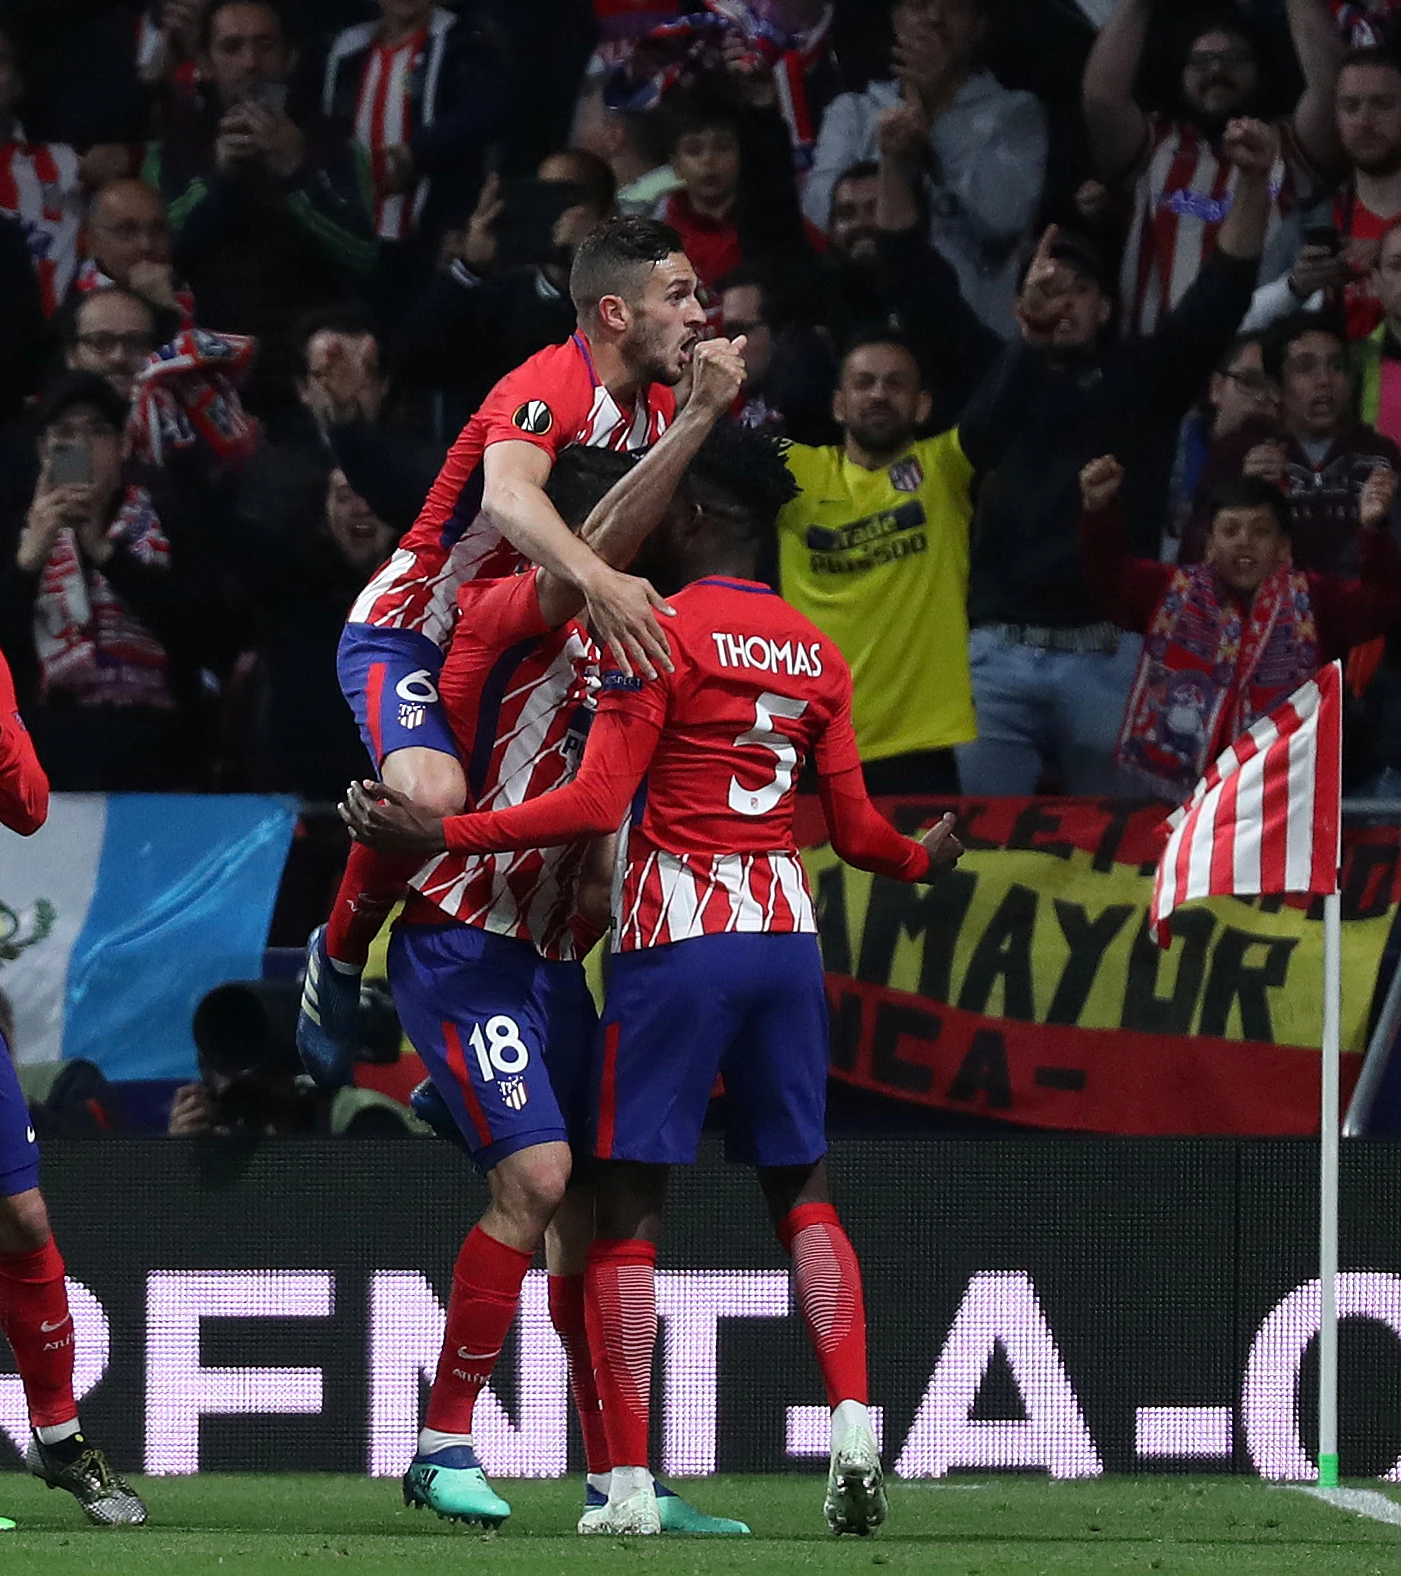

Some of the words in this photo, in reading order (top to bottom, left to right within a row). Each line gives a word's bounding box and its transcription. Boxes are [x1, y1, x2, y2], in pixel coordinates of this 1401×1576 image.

[712, 632, 822, 677] THOMAS
[396, 669, 439, 703] 6
[728, 691, 809, 816] 5
[468, 1015, 530, 1082] 18
